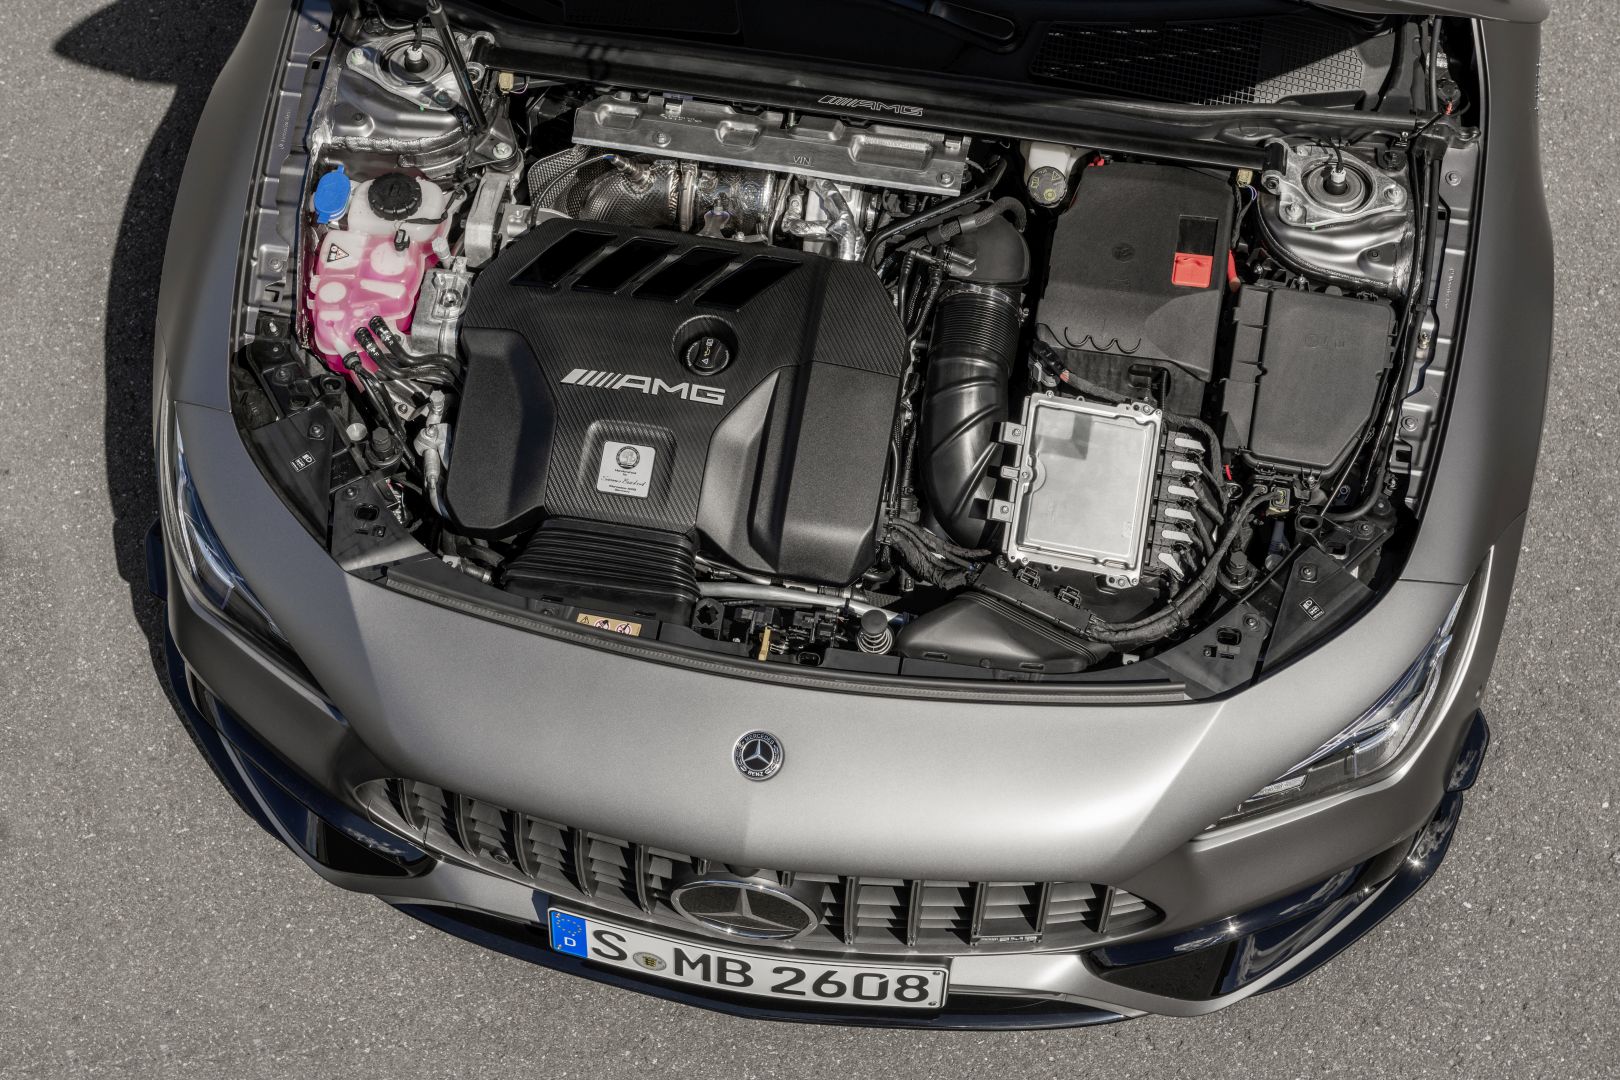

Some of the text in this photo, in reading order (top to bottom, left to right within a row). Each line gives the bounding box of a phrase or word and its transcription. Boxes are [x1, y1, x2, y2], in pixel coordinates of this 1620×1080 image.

[852, 99, 923, 116] AMG
[793, 155, 811, 165] VIN
[612, 374, 726, 406] AMG
[563, 936, 577, 948] D
[592, 929, 930, 1002] S MB 2608
